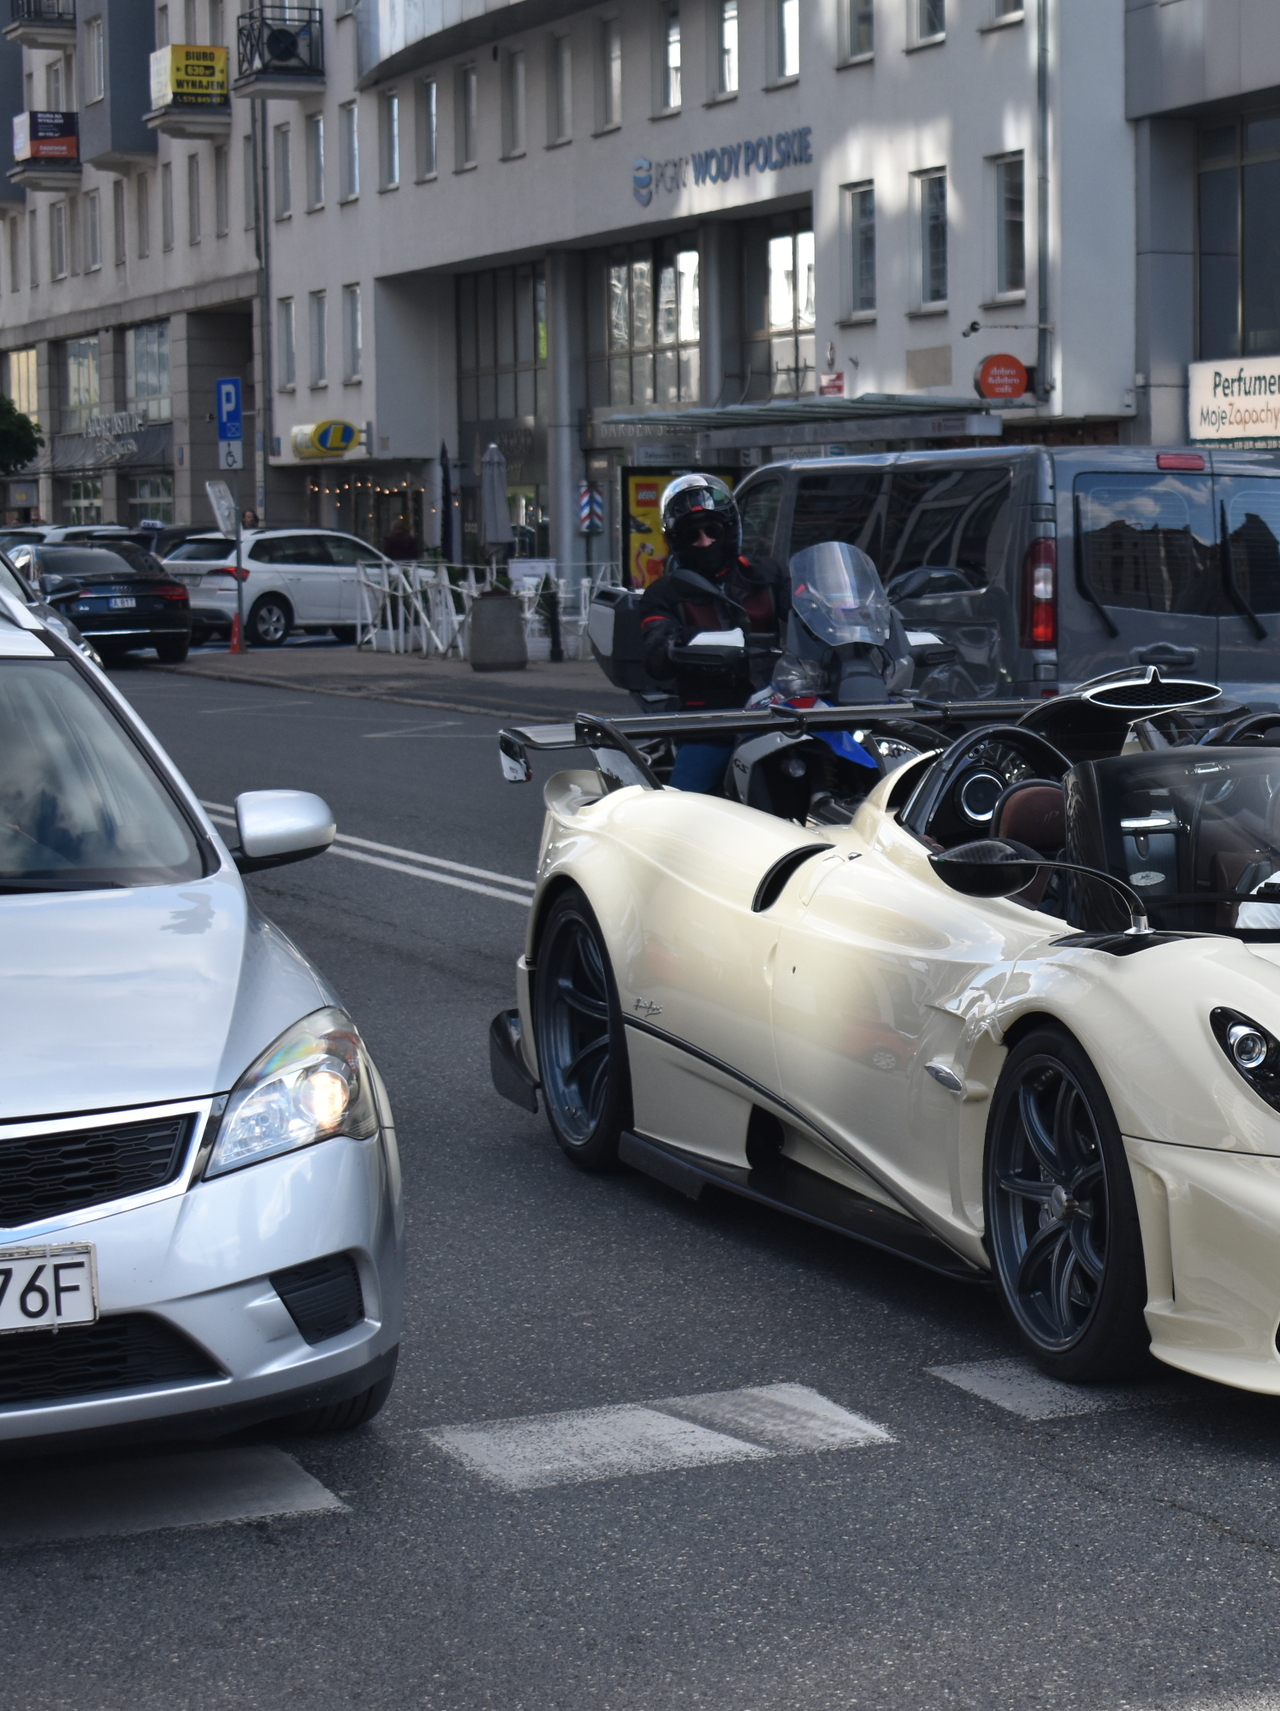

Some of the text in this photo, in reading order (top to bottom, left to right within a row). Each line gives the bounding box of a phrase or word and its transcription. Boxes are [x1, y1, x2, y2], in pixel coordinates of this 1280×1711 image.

[185, 51, 215, 62] BIURO
[187, 66, 205, 76] 630
[176, 79, 225, 90] WYNAJEM
[691, 143, 742, 187] WODY
[743, 126, 812, 177] POLSKIE
[990, 367, 1016, 376] dobro
[221, 384, 236, 422] P
[638, 490, 658, 500] LEGO
